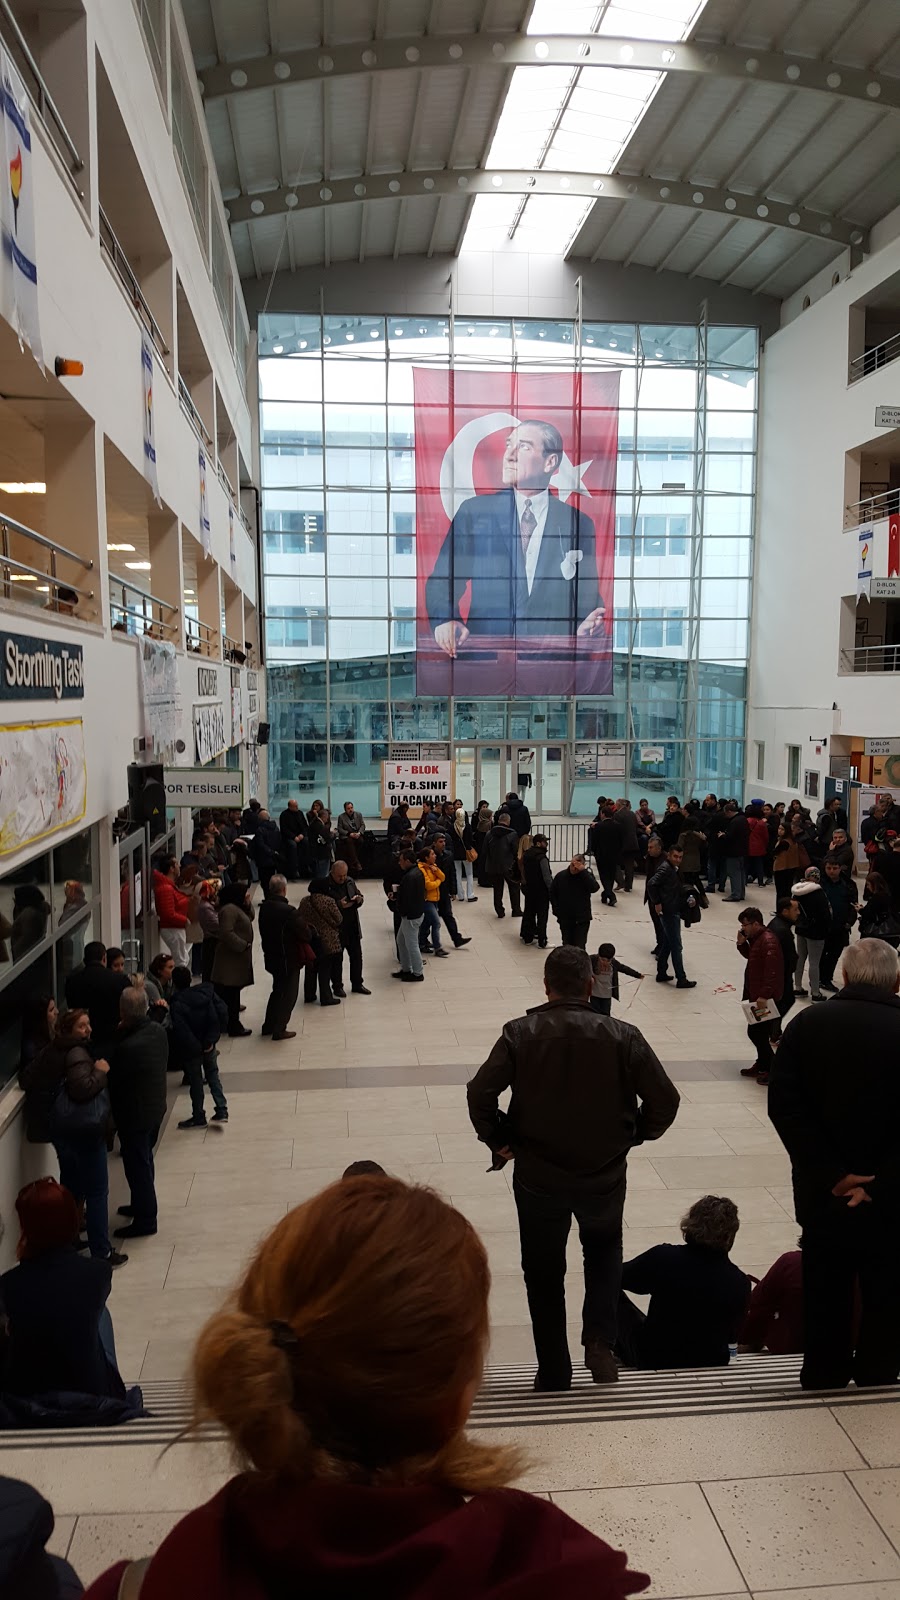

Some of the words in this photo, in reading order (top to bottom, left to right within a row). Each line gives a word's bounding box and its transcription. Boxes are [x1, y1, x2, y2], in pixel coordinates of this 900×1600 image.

[6, 639, 62, 699] Storming
[396, 765, 402, 774] F
[411, 765, 439, 774] BLOK
[186, 783, 241, 793] TESİSLERİ
[387, 781, 447, 790] 6-7-8.SINIF
